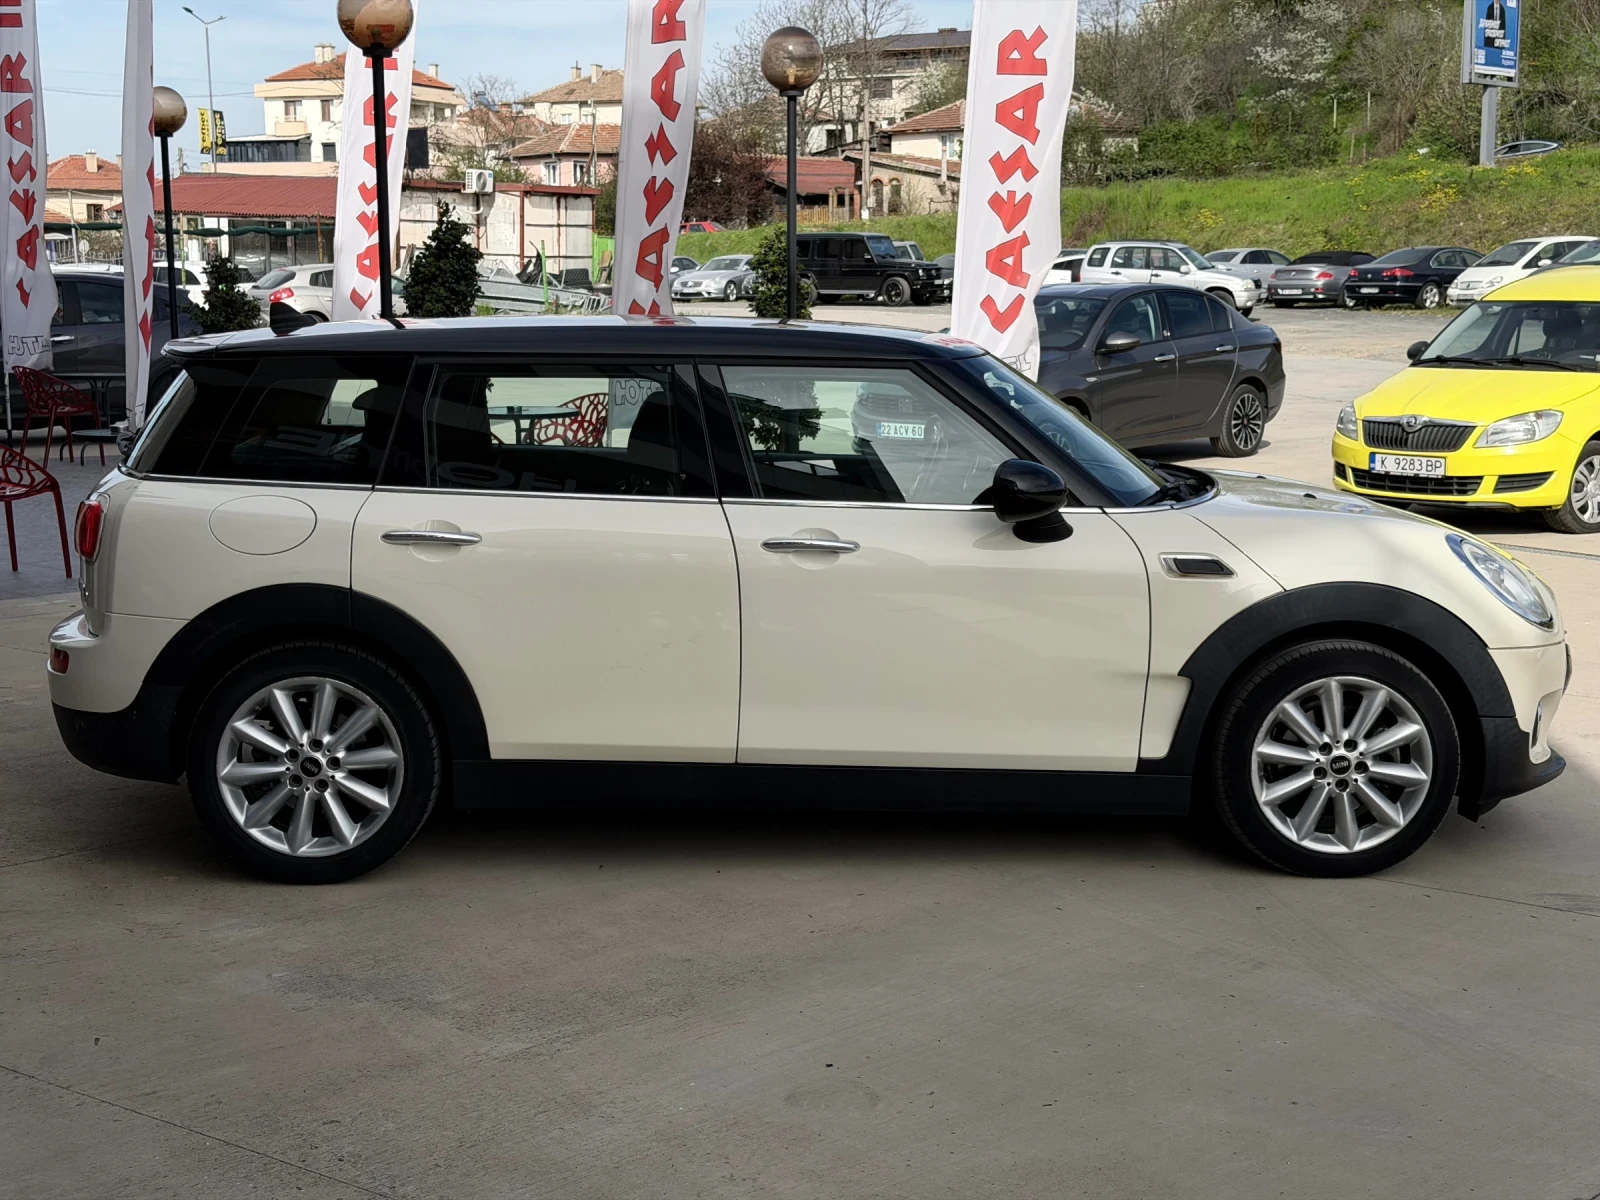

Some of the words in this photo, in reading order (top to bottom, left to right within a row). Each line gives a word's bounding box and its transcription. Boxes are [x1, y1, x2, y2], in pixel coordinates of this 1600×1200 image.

[980, 25, 1048, 334] CAESAR
[881, 424, 891, 435] 22
[893, 425, 909, 436] ACV
[911, 426, 923, 437] 60
[1380, 456, 1388, 469] K
[1394, 457, 1423, 472] 9283
[1425, 459, 1443, 473] BP
[303, 761, 319, 773] MINI
[1331, 760, 1349, 770] MINI
